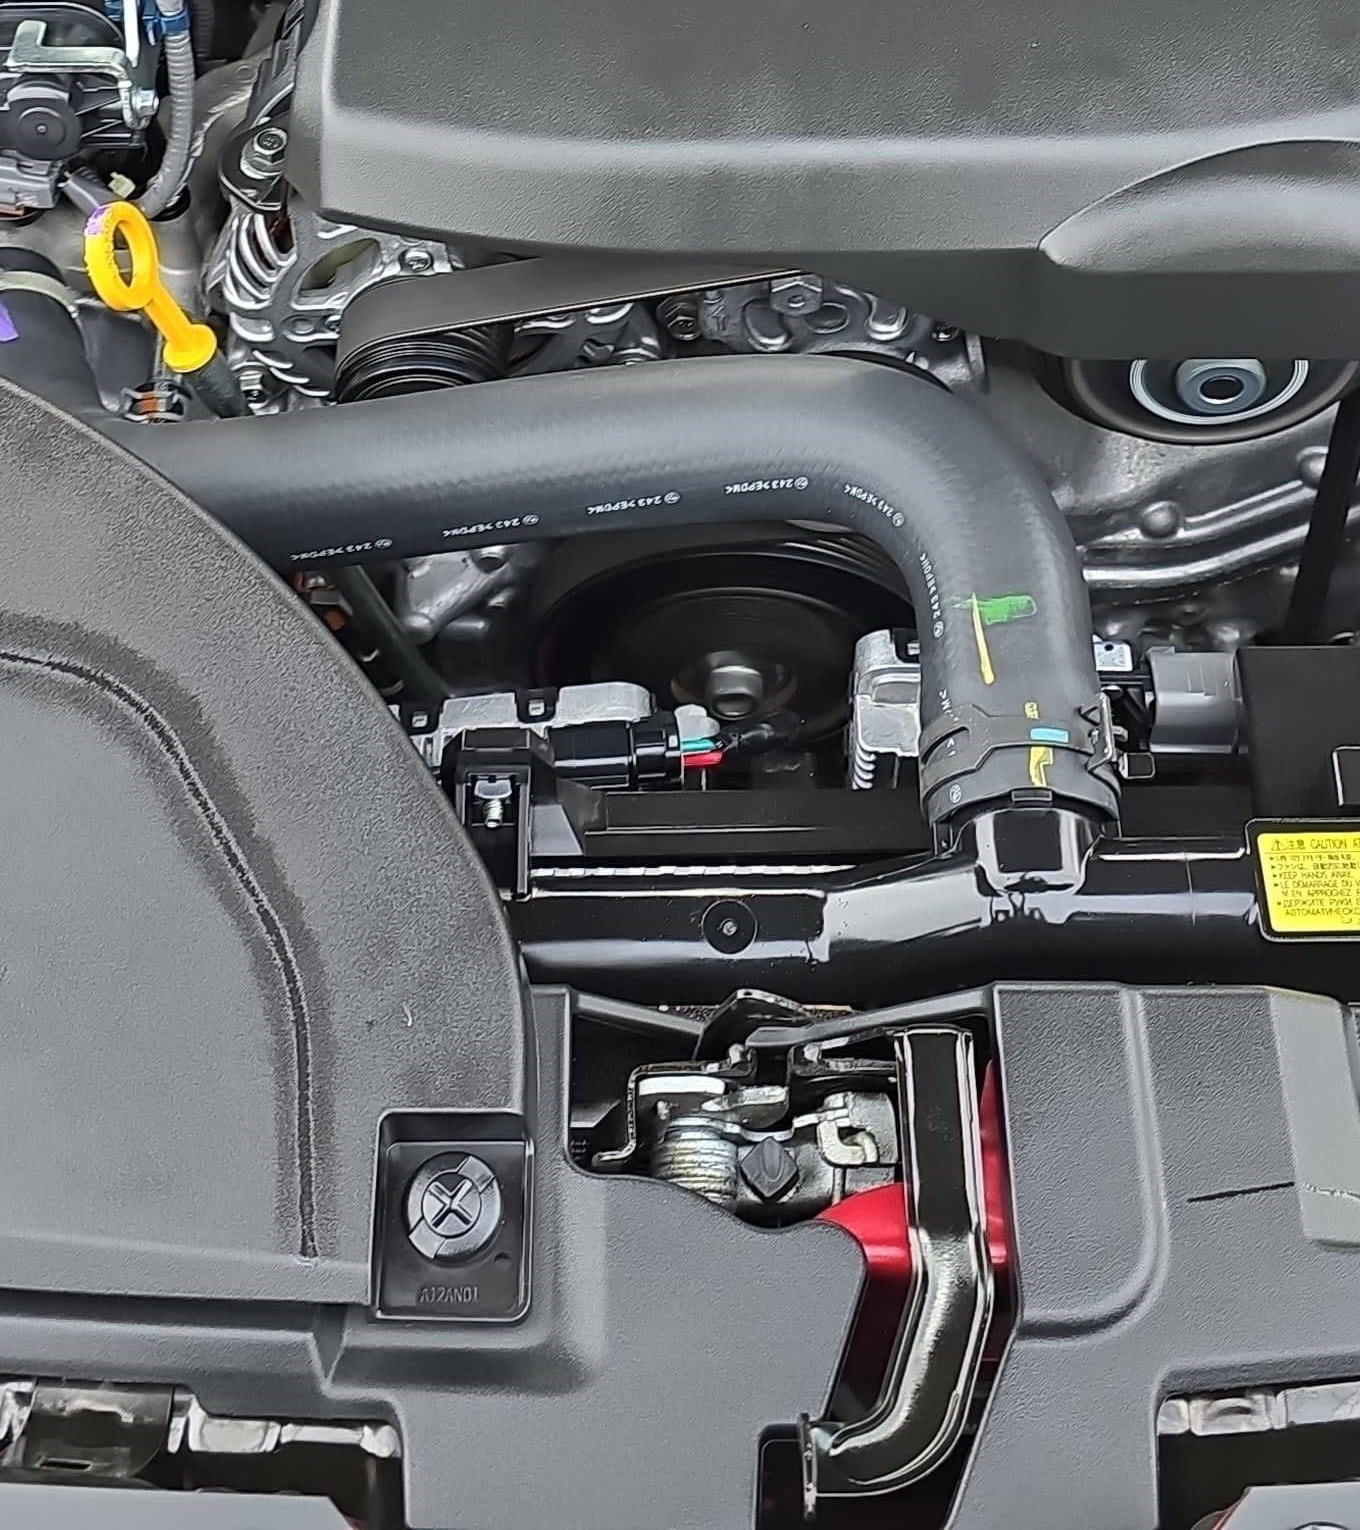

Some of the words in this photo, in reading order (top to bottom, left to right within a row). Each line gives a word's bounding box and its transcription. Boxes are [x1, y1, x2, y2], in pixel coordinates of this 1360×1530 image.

[1310, 838, 1348, 850] CAUTION
[1279, 871, 1298, 880] KEEP
[1280, 880, 1290, 889] LE
[1341, 878, 1353, 887] DU
[1307, 888, 1352, 898] APPROCHEZ
[1283, 898, 1325, 908] ДЕРЖИТЕ
[1329, 897, 1352, 907] РУКИ
